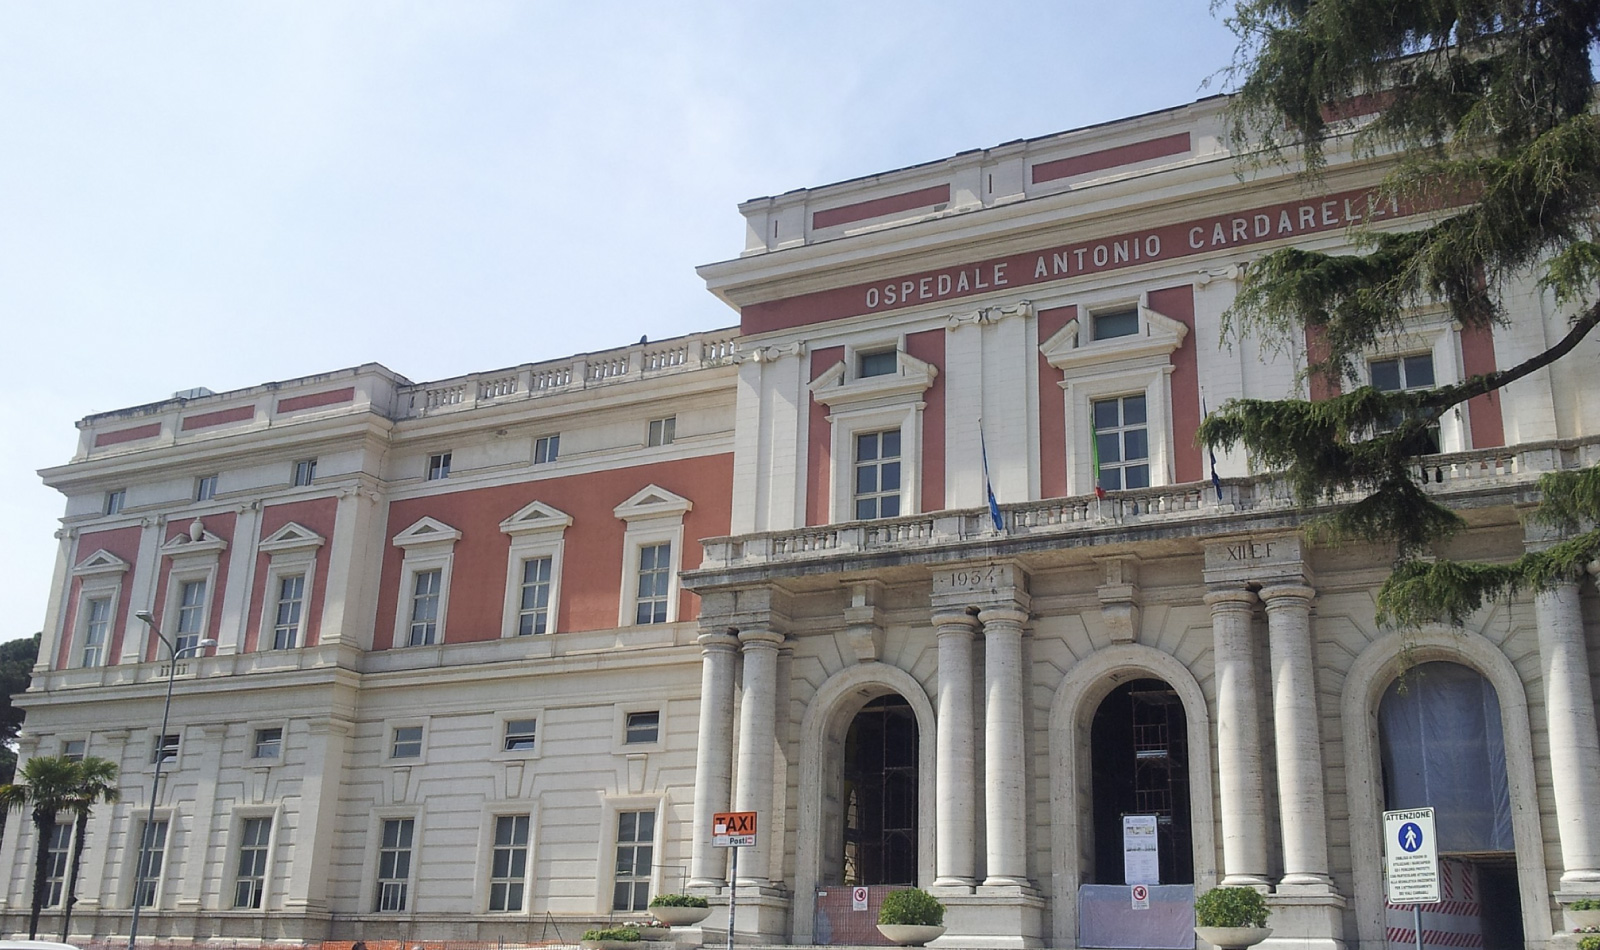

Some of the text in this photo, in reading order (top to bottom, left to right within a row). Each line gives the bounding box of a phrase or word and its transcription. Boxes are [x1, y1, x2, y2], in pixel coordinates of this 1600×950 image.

[866, 263, 1008, 308] OSPEDALE
[1034, 234, 1161, 278] ANTONIO
[1226, 545, 1246, 561] XII
[951, 566, 996, 587] 1934
[715, 816, 753, 831] TAXI
[1386, 811, 1431, 821] ATTENZIONE
